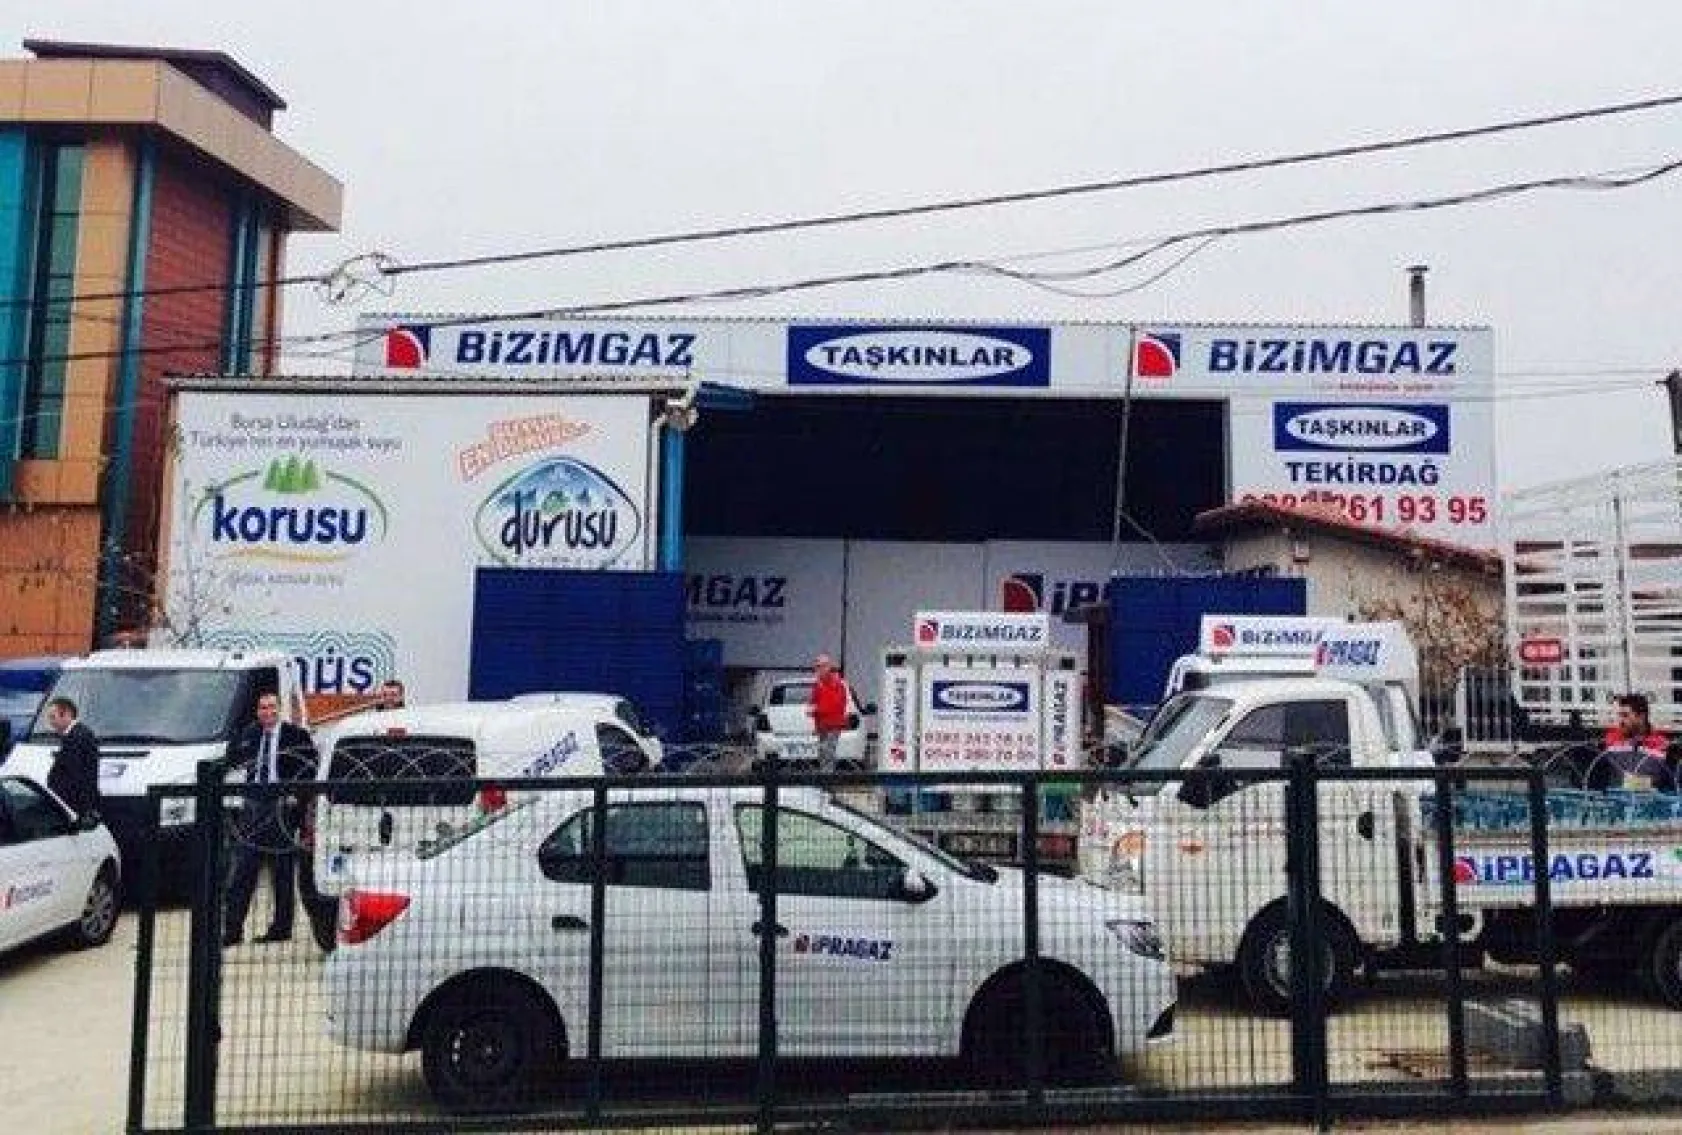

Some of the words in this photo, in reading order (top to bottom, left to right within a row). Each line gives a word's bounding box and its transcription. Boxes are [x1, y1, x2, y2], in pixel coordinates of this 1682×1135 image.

[822, 346, 1015, 370] TAŞKINLAR
[1296, 419, 1426, 439] TAŞKINLAR
[1286, 457, 1440, 485] TEKİRDAĞ
[212, 493, 366, 543] korusu
[501, 490, 616, 554] durusu
[1399, 495, 1436, 523] 93
[1448, 496, 1487, 524] 95
